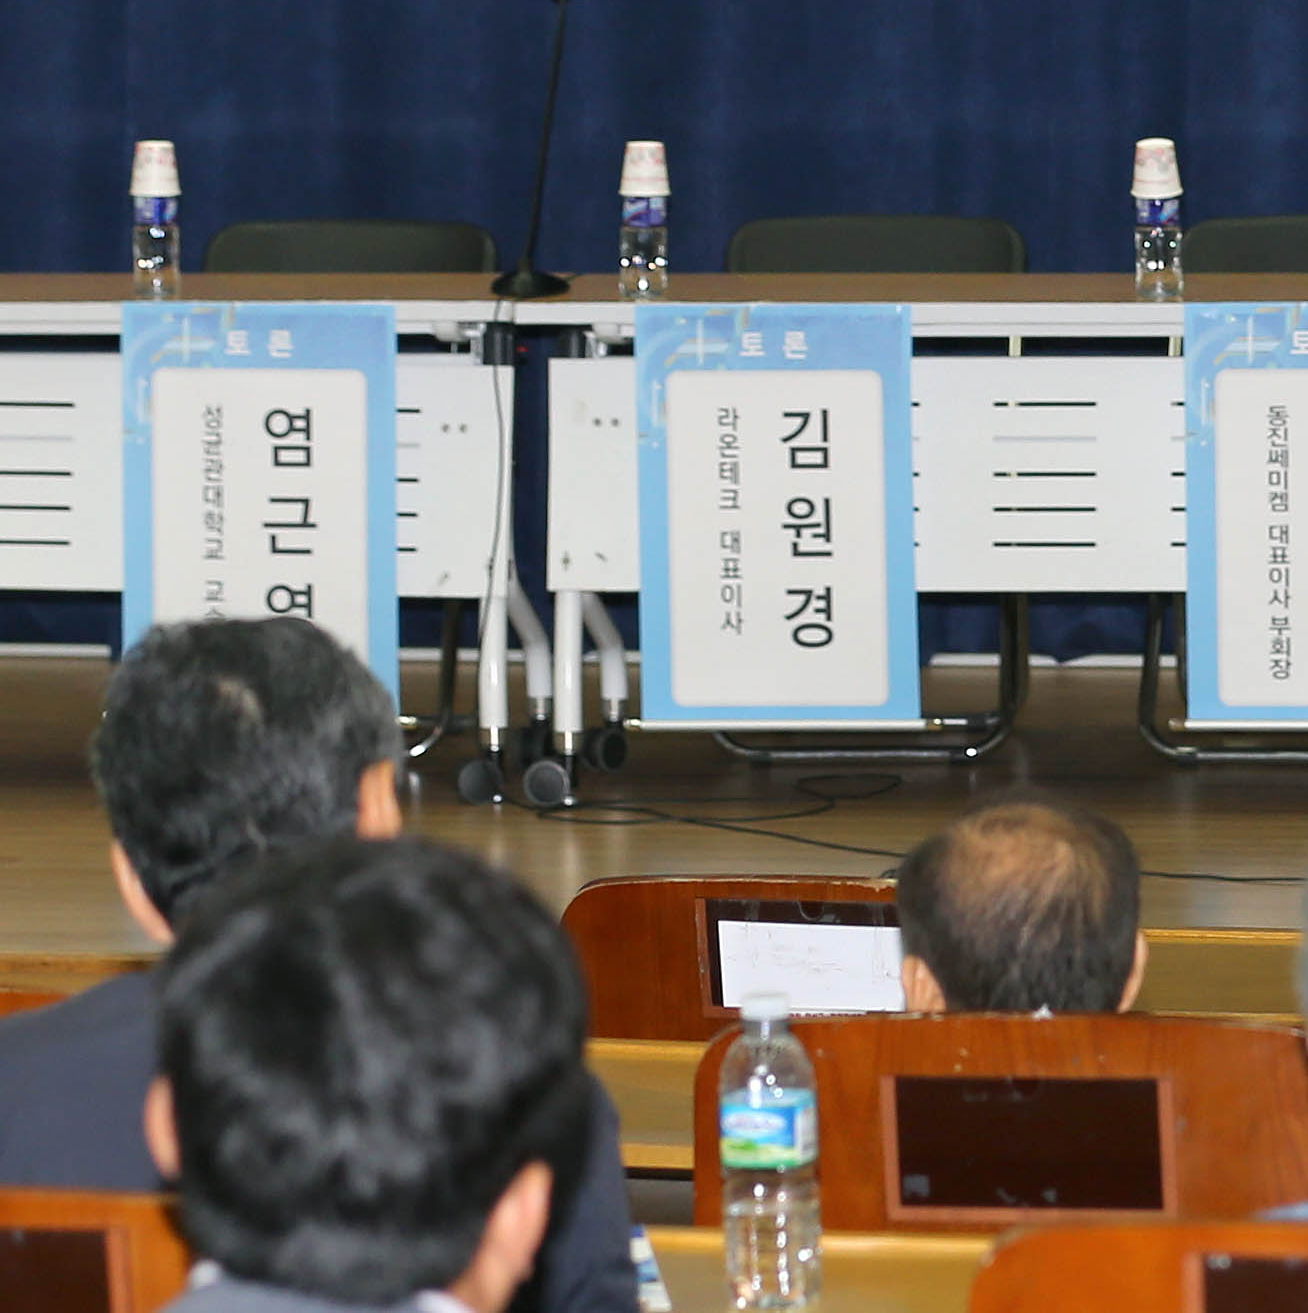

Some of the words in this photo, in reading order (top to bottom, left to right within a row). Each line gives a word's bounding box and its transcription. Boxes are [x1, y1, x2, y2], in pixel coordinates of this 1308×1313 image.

[717, 405, 741, 511] 라온테크
[1266, 404, 1290, 513] 동진쎄미켐
[779, 408, 835, 650] 김원경
[1268, 524, 1292, 609] 대표이사
[720, 529, 744, 636] 대표이사
[1268, 615, 1293, 681] 부회장
